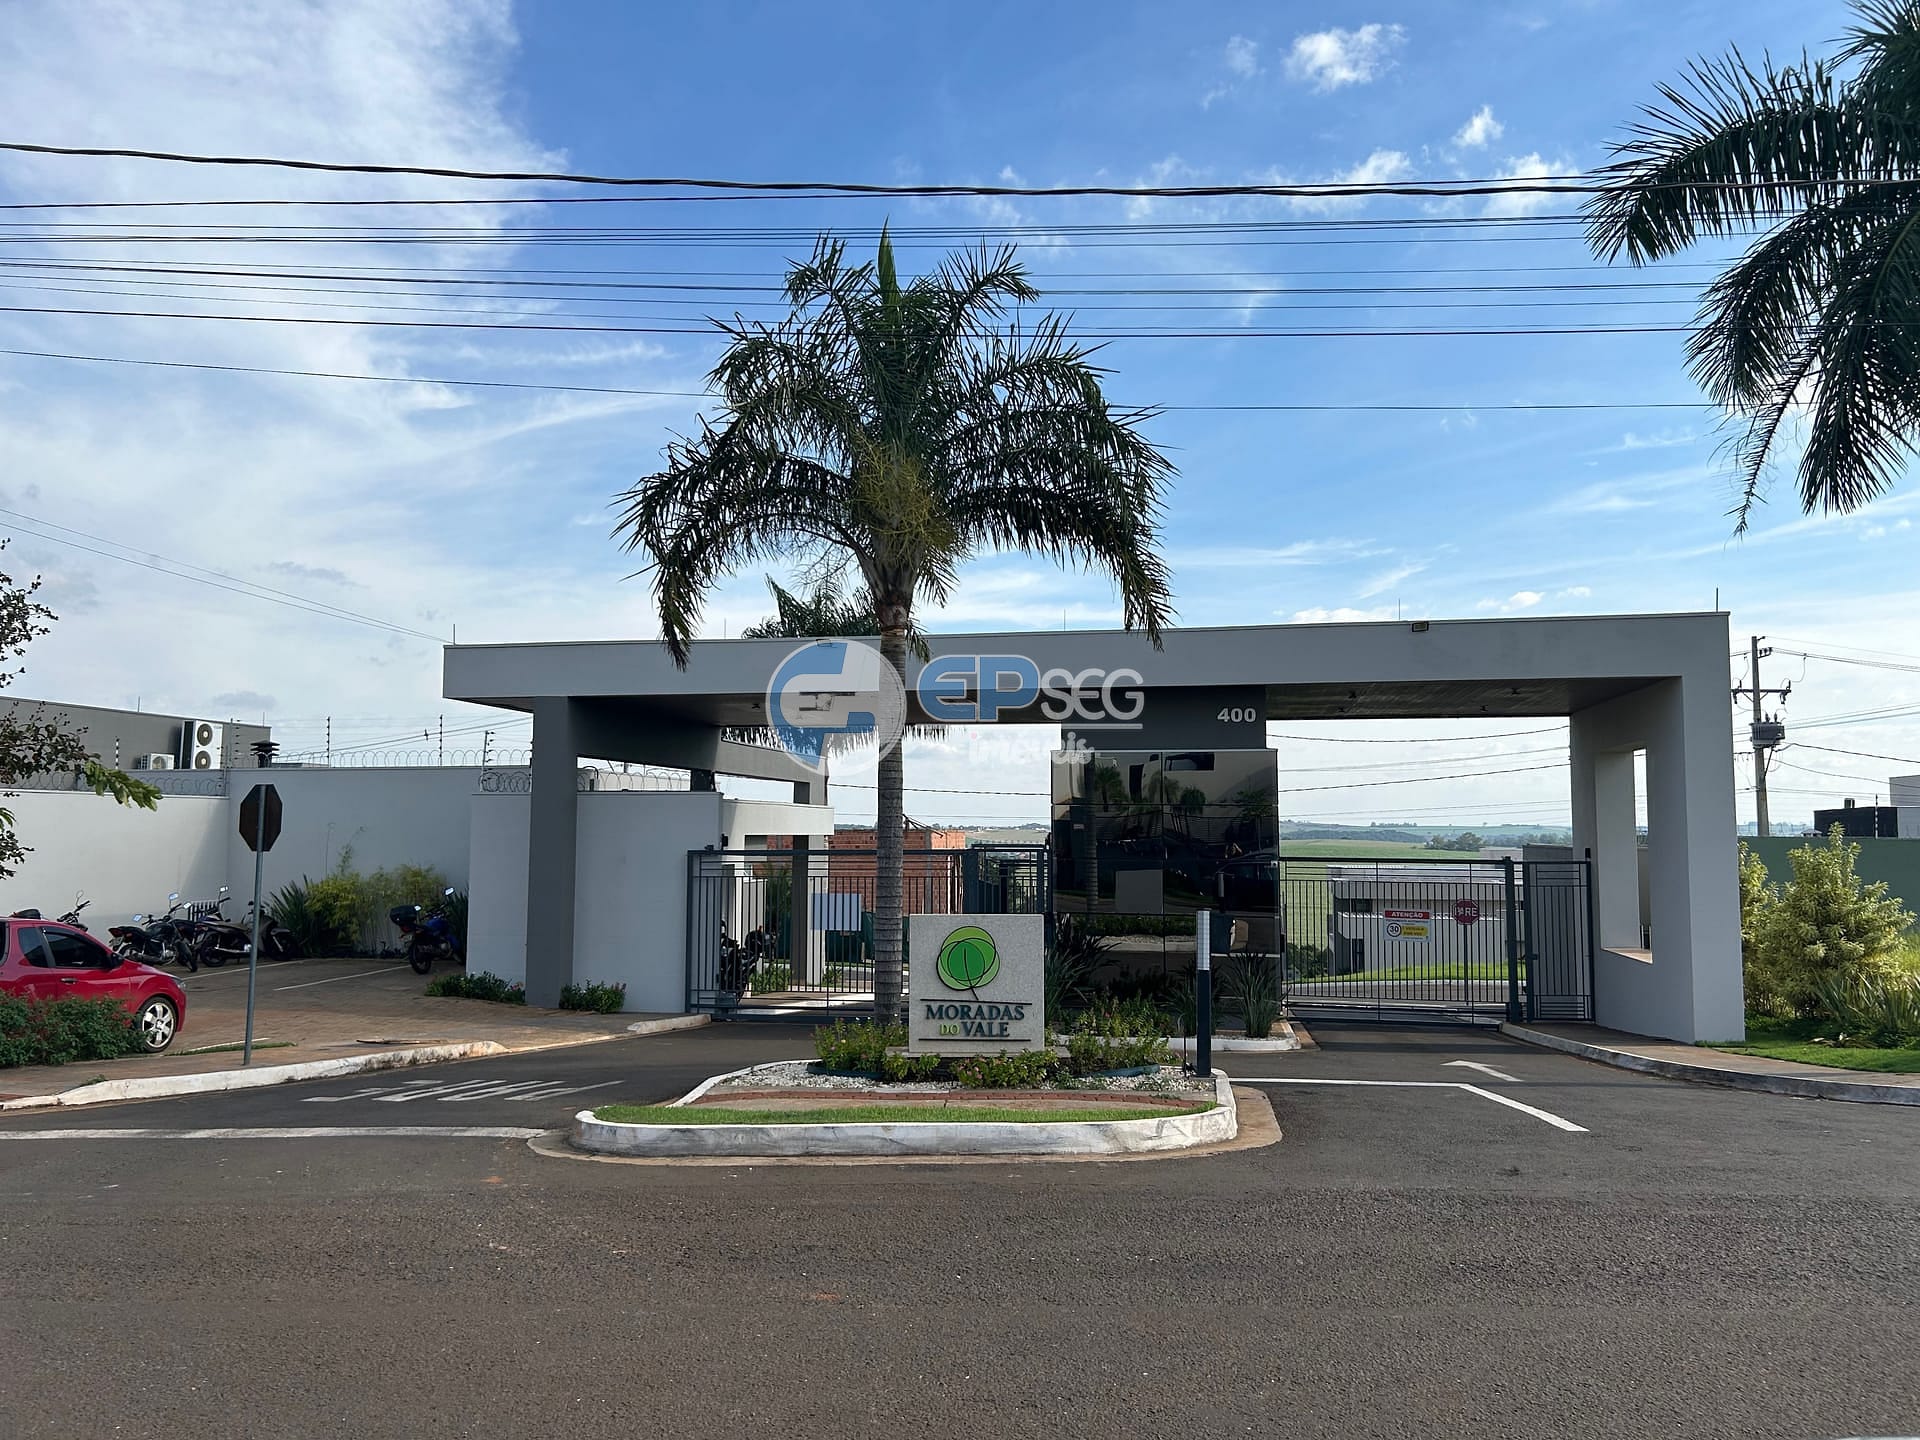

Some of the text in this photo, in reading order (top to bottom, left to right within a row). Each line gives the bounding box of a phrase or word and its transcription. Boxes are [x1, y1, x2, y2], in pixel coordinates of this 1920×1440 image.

[1217, 708, 1256, 722] 400
[925, 1004, 1025, 1021] MORADAS
[940, 1021, 1010, 1038] DO VALE
[299, 1079, 625, 1102] PARE
